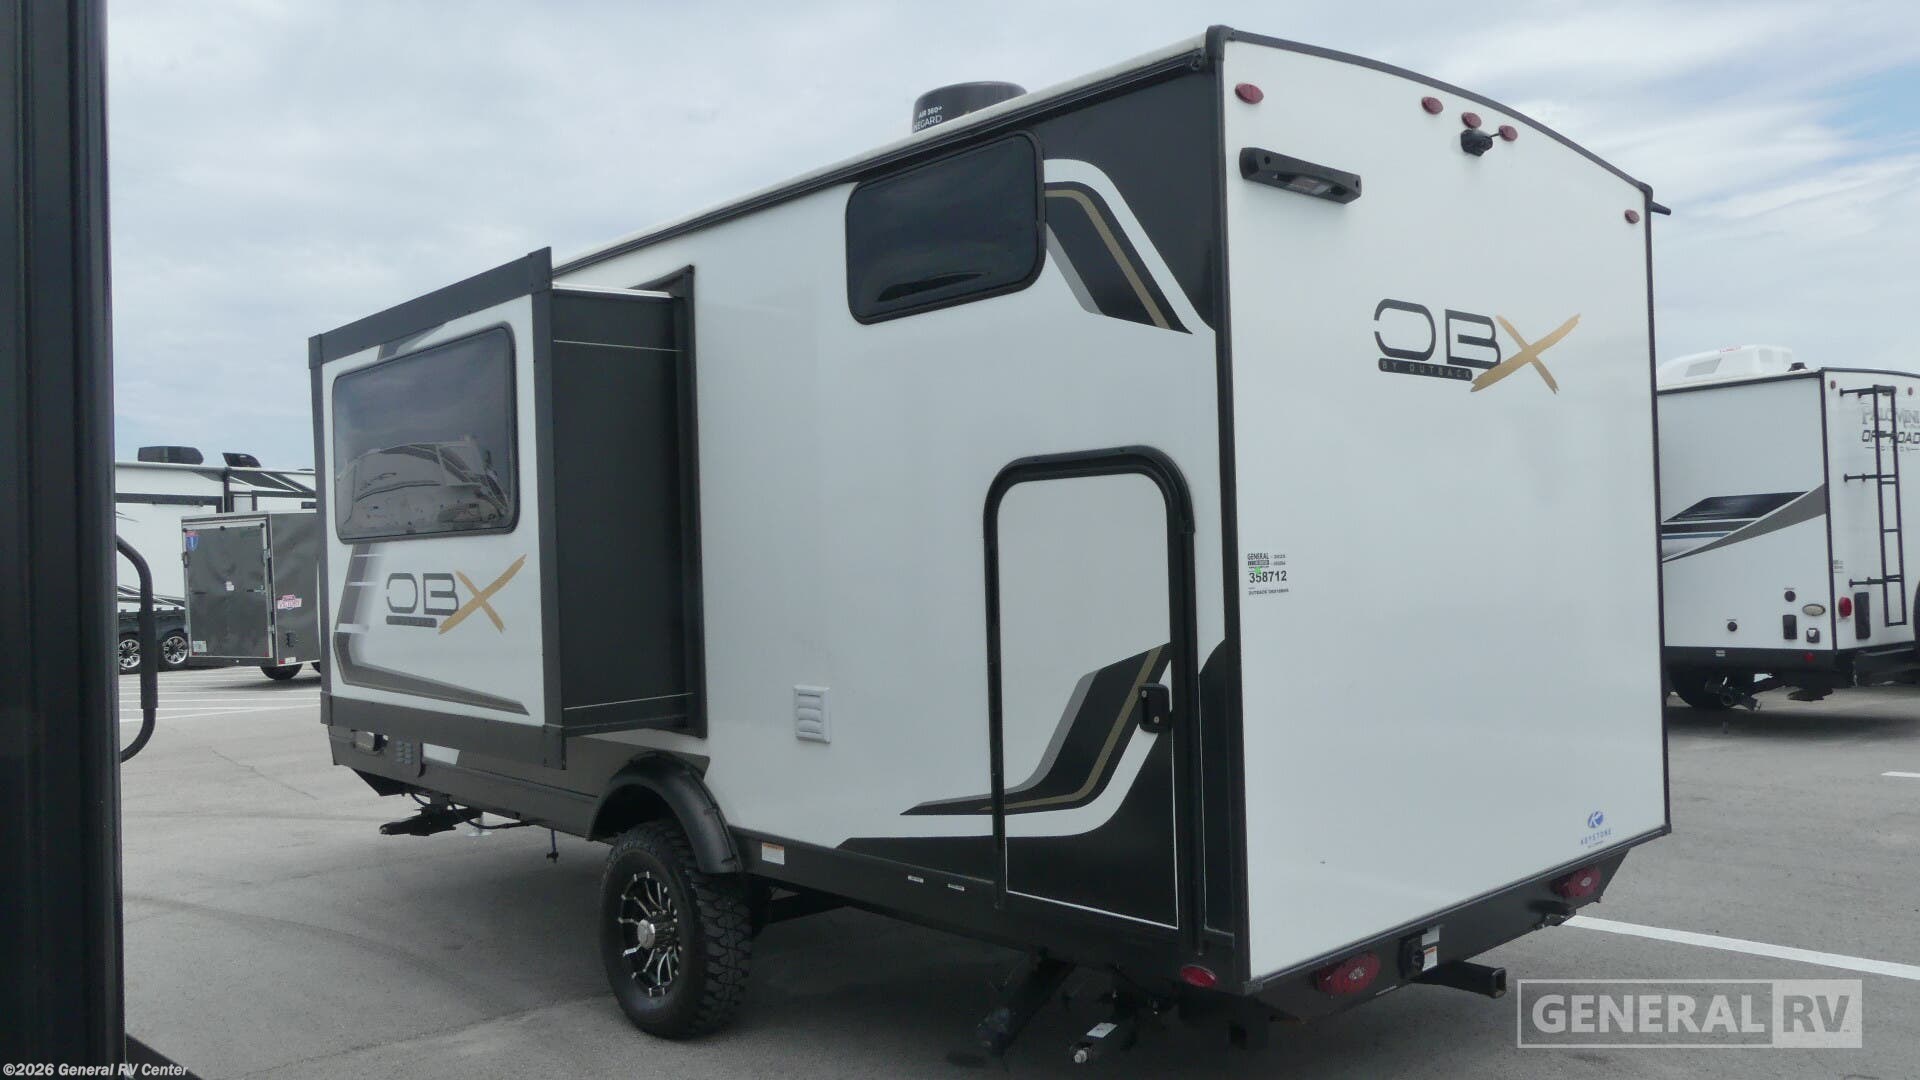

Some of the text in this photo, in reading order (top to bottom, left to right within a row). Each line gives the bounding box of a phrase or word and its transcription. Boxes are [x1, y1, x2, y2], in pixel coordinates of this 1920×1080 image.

[918, 110, 926, 119] AIR
[1373, 298, 1581, 395] OBX
[1382, 360, 1471, 379] BY OUTBACK
[1249, 570, 1287, 583] 358712
[385, 553, 527, 635] OBX
